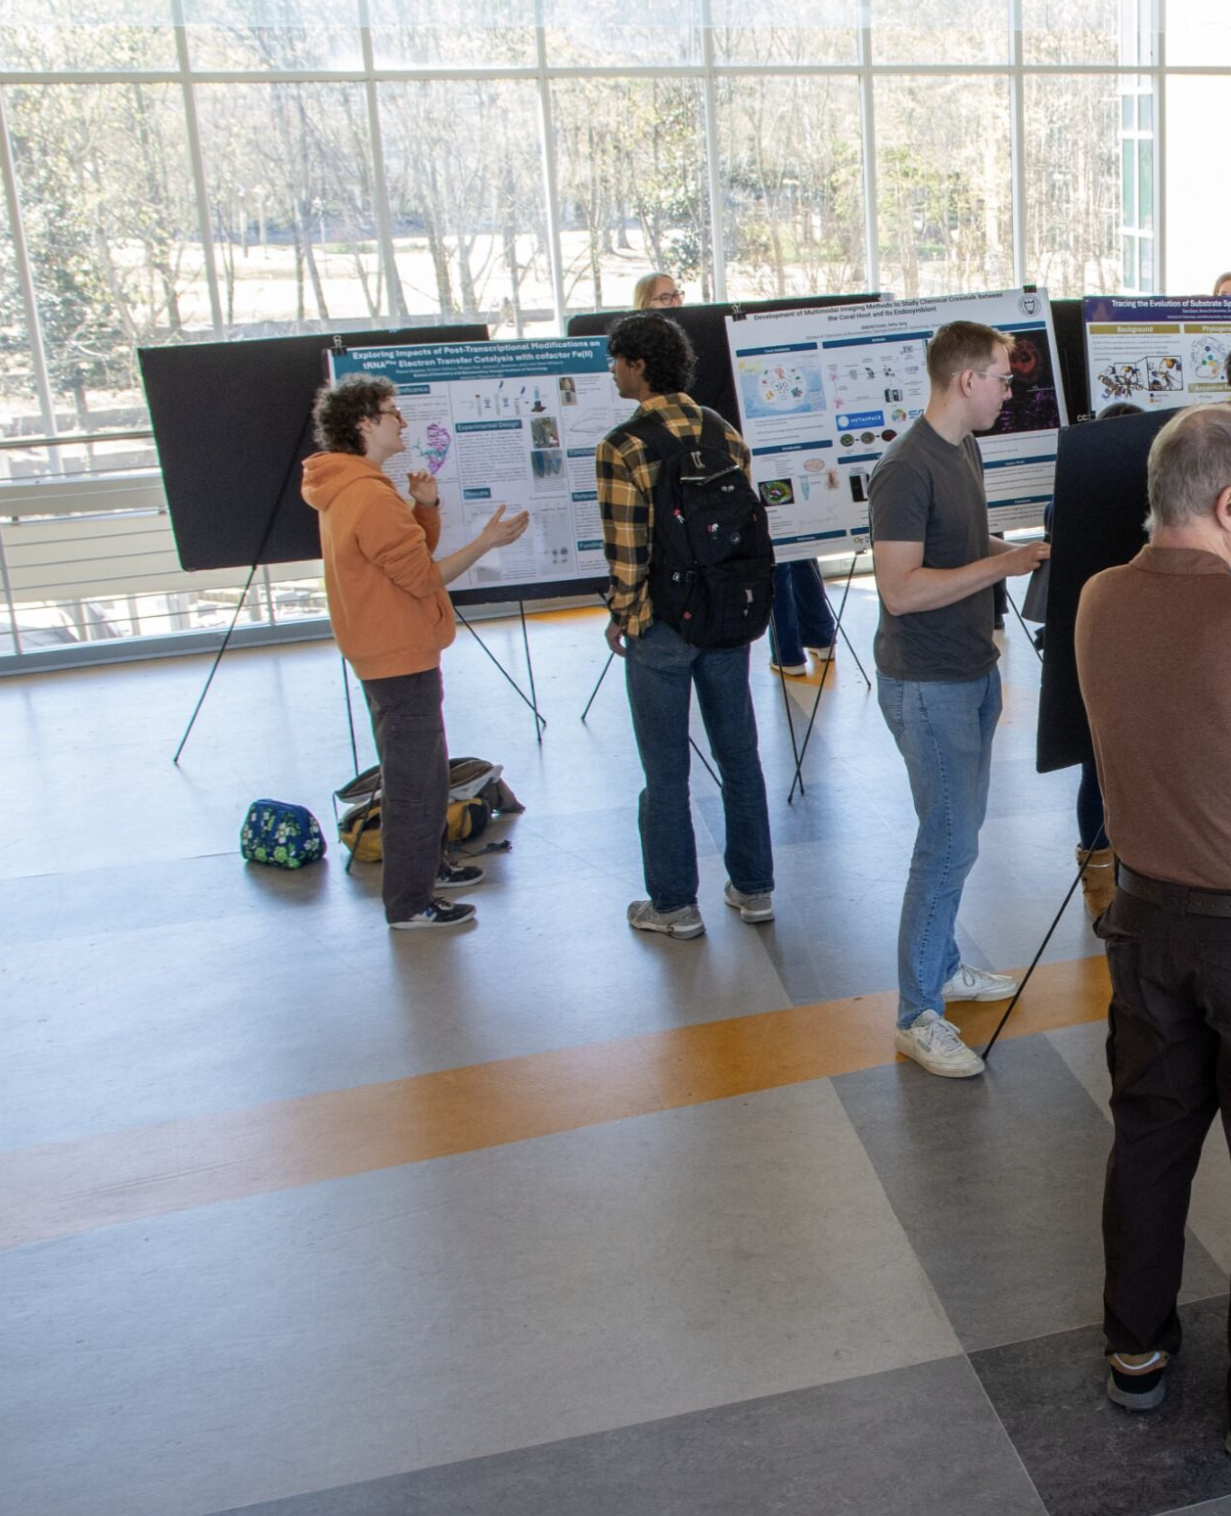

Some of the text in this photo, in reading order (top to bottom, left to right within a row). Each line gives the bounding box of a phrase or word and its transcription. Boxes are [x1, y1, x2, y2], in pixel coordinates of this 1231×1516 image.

[754, 312, 795, 320] Development
[804, 307, 839, 316] Multimodal
[840, 305, 865, 313] Imaging
[902, 300, 919, 308] Study
[1111, 300, 1136, 308] Tracing
[894, 306, 936, 315] Endosymbiont
[352, 350, 395, 360] Exploring
[396, 349, 431, 358] Impacts
[444, 342, 530, 354] Post-Transcriptional
[531, 341, 588, 350] Modifications
[398, 359, 436, 368] Electron
[437, 357, 472, 366] Transfer
[474, 354, 514, 363] Catalysis
[515, 353, 534, 361] with
[535, 352, 570, 360] cofactor
[458, 422, 498, 430] Experimental
